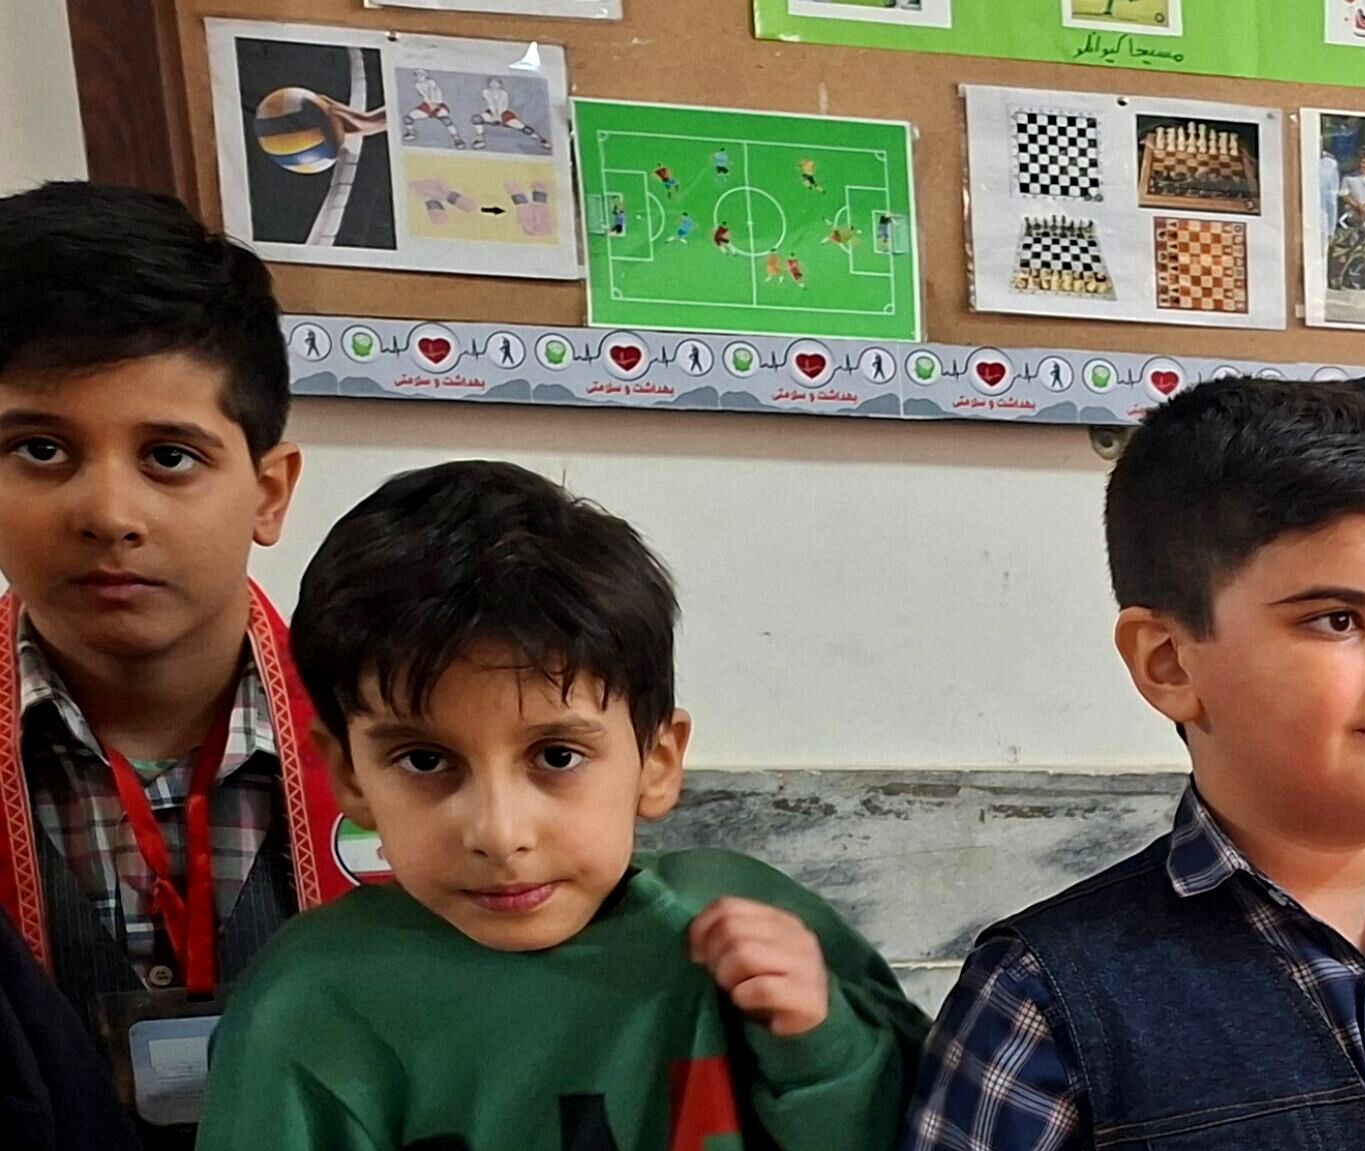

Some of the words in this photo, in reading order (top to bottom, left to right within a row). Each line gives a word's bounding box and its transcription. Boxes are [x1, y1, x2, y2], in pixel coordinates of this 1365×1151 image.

[394, 374, 433, 388] سلامتی
[442, 375, 486, 388] بهداشت
[586, 380, 621, 395] سلامتی
[632, 383, 675, 395] بهداشت
[771, 388, 808, 402] سلامتی
[817, 390, 858, 404] بهداشت
[952, 395, 988, 408] سلامتی
[998, 397, 1037, 411] بهداشت
